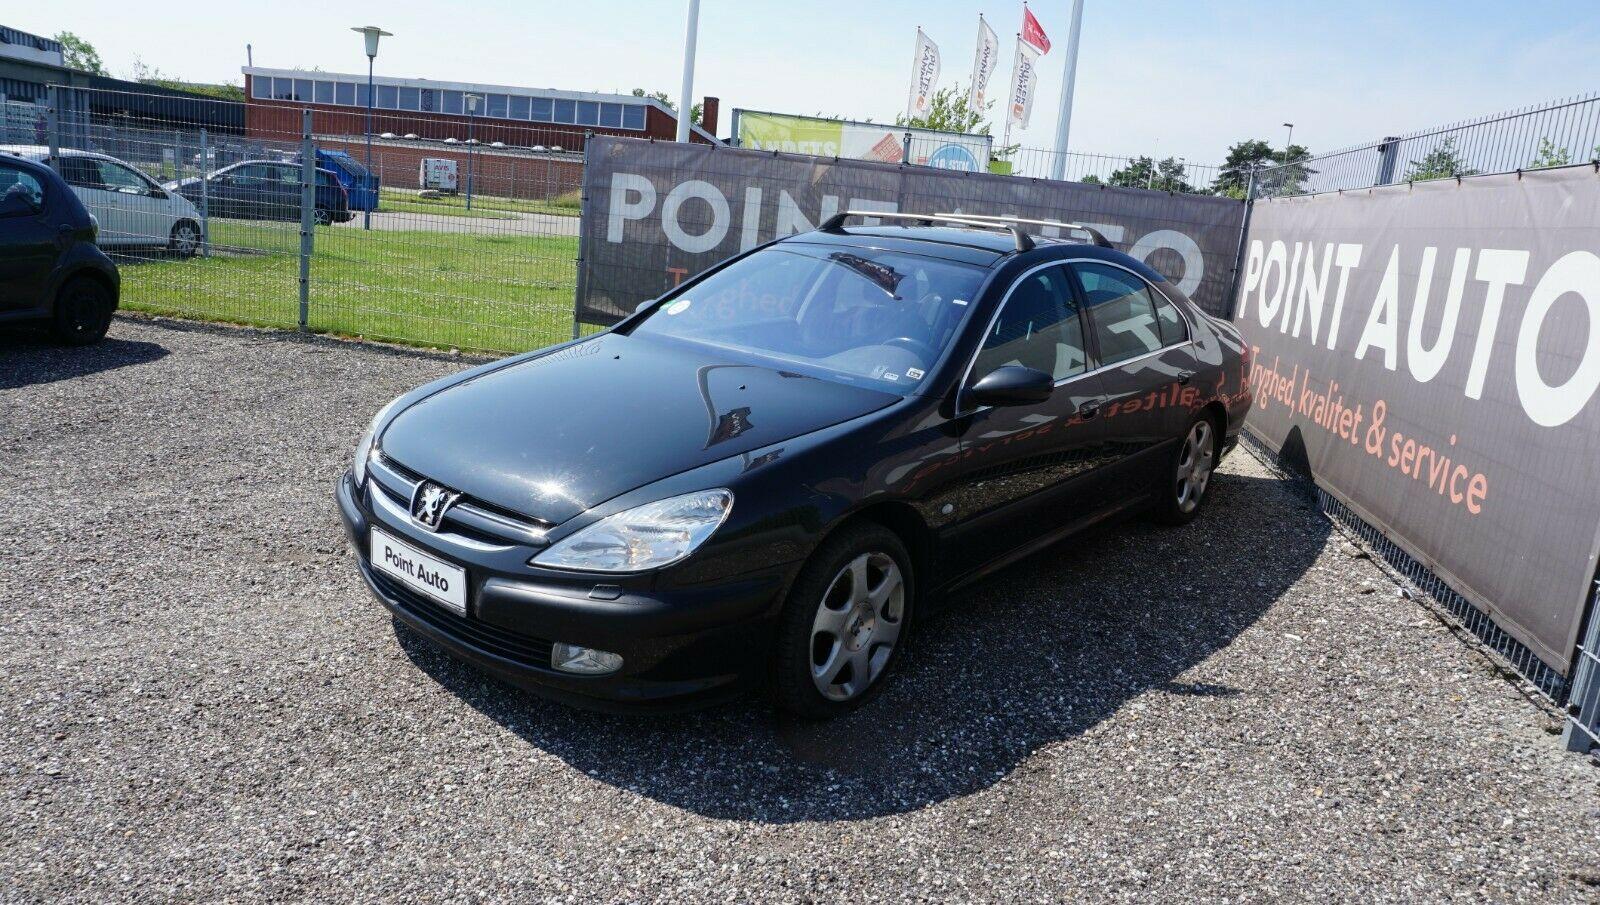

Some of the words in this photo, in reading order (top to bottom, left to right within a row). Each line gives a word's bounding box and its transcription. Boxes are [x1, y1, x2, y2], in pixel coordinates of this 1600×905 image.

[1238, 239, 1363, 351] POINT
[1354, 243, 1600, 428] AUTO
[1249, 345, 1298, 418] Tryghed,
[1299, 368, 1363, 445] kvalitet
[1365, 399, 1387, 459] &
[1387, 432, 1488, 515] service
[385, 545, 415, 577] Point
[417, 563, 449, 592] Auto
